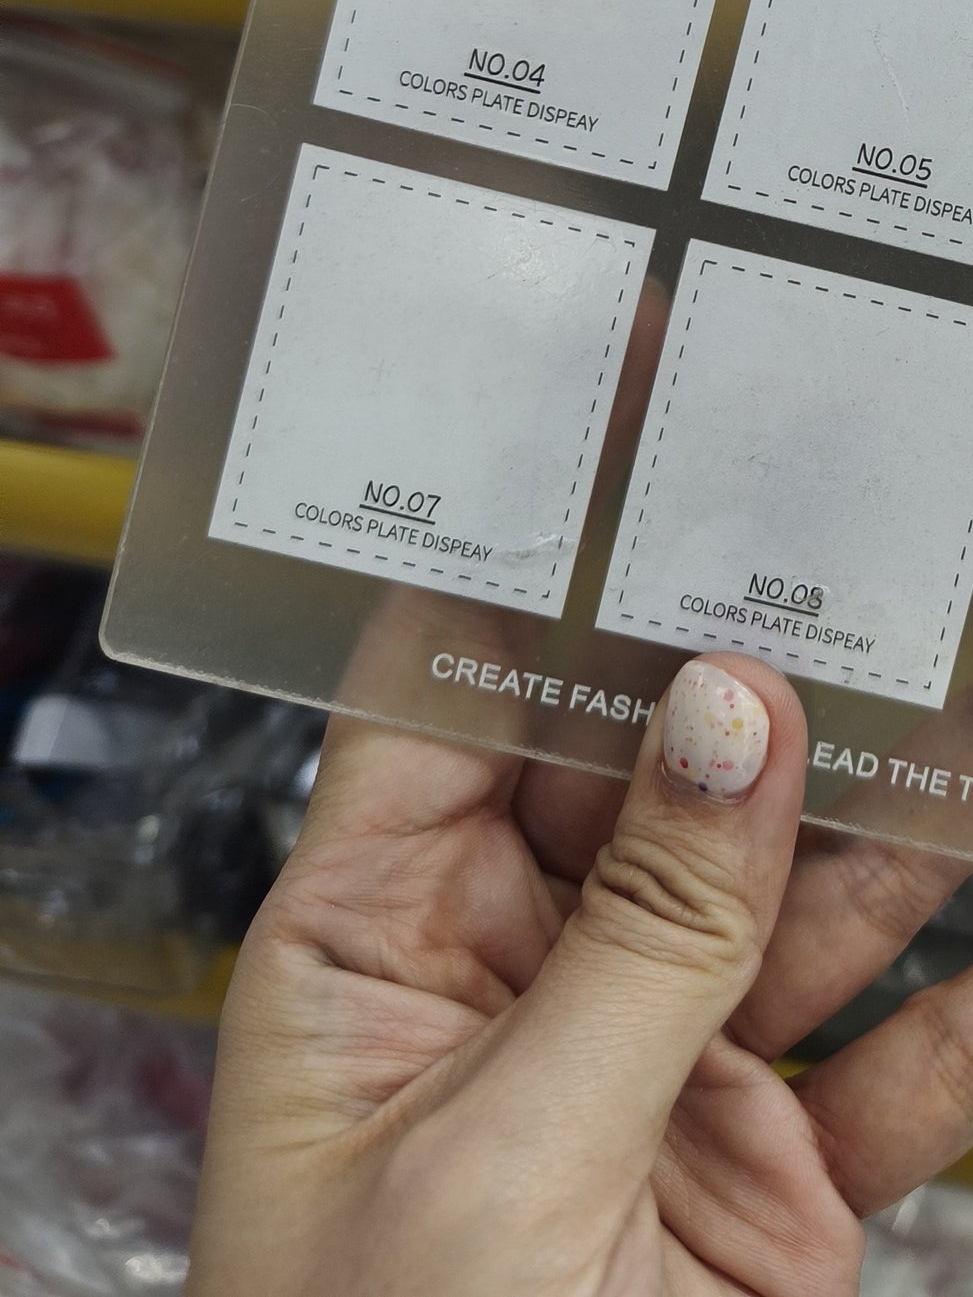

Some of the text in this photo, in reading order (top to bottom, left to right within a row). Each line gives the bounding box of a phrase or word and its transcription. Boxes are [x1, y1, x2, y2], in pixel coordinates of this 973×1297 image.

[468, 48, 546, 87] NO.04
[399, 70, 600, 133] COLORS PLATE DISPEAY
[787, 165, 856, 195] COLORS
[858, 182, 912, 209] PLATE
[857, 142, 933, 181] NO.05
[364, 480, 442, 518] NO.07
[294, 502, 493, 562] COLORS PLATE DISPEAY
[680, 594, 876, 653] COLORS PLATE DISPEAY
[431, 653, 564, 706] CREATE
[569, 683, 656, 727] FASH
[806, 741, 879, 778] EAD
[888, 757, 952, 797] THE
